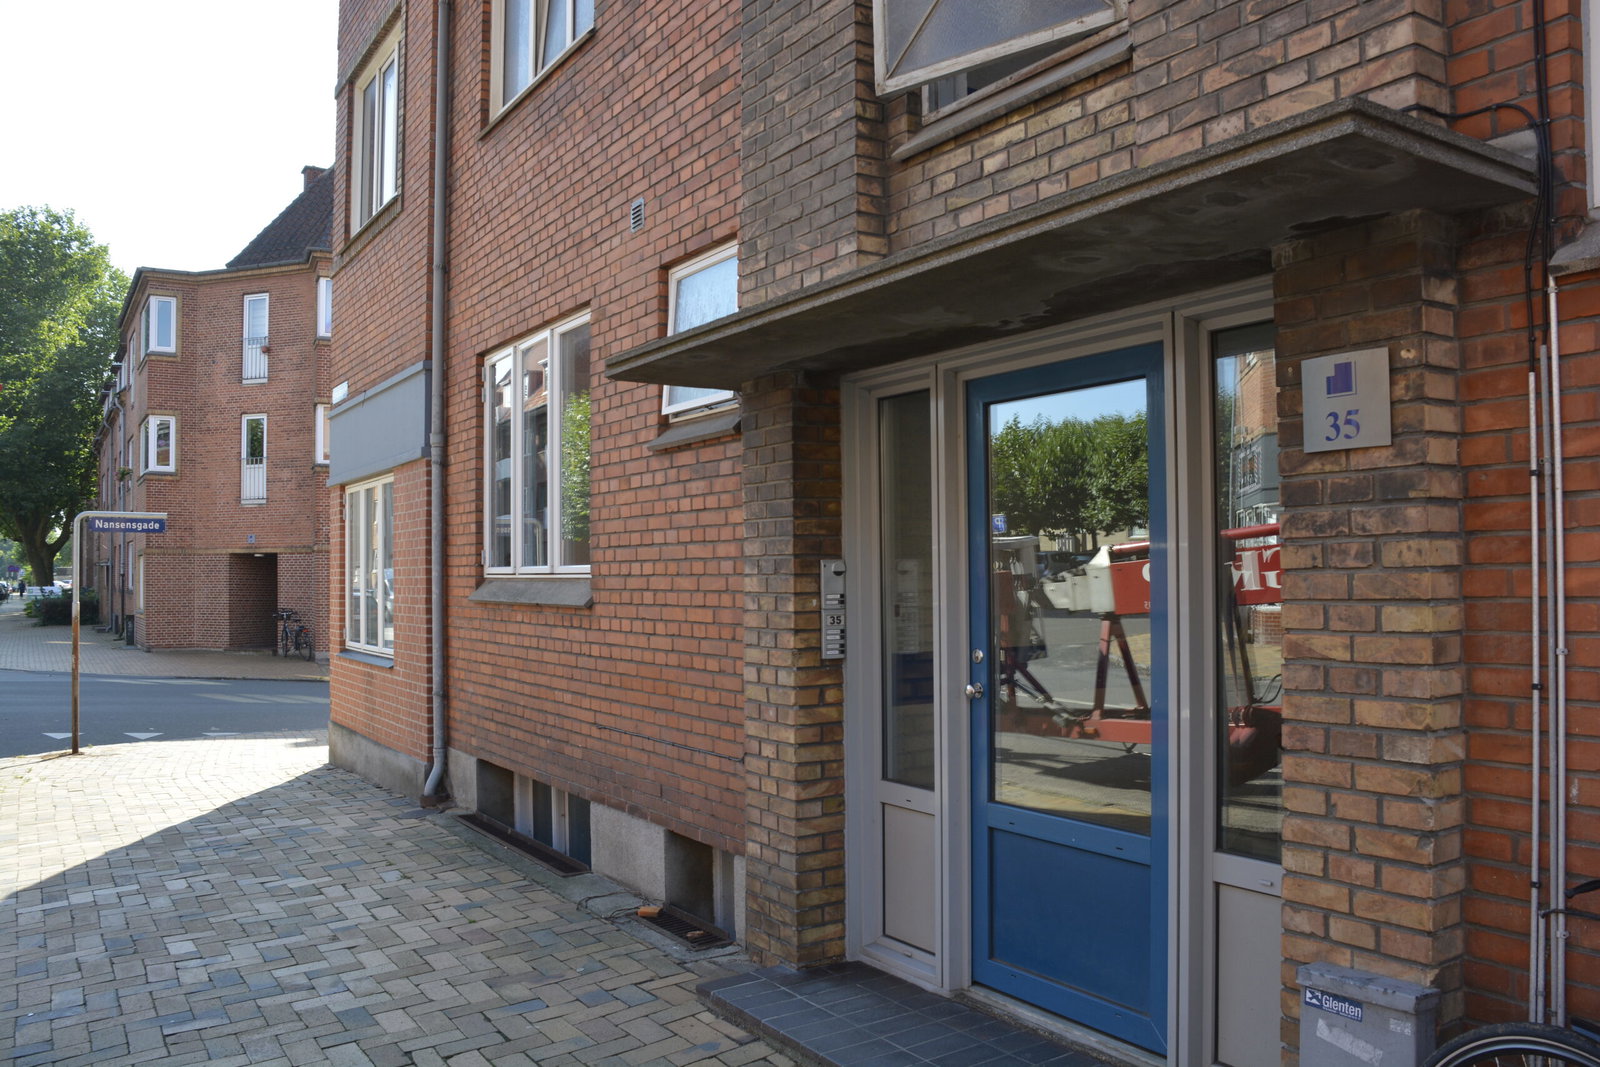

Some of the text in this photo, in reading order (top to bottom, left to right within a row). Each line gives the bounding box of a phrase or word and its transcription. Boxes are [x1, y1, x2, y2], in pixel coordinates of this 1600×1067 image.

[1325, 409, 1360, 441] 35
[95, 519, 160, 531] Nansensgade
[829, 615, 842, 625] 35
[1322, 994, 1362, 1018] Glenten
